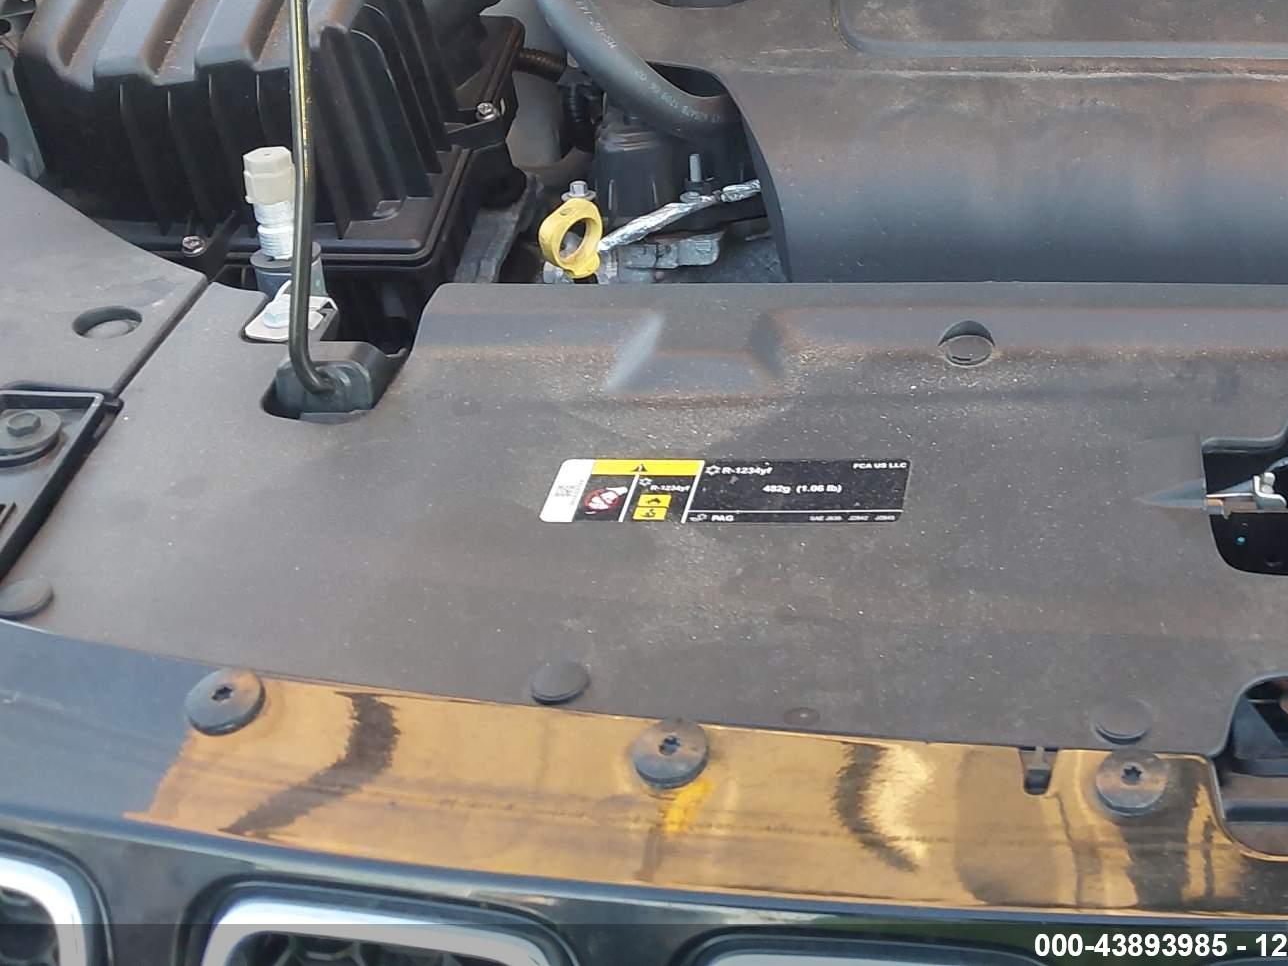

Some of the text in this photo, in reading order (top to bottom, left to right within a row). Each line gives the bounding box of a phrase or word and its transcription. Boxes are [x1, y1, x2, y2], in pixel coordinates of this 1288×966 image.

[853, 462, 872, 470] FCA
[888, 461, 907, 469] LLC
[721, 466, 773, 476] R-1234yf
[711, 514, 735, 522] PAG
